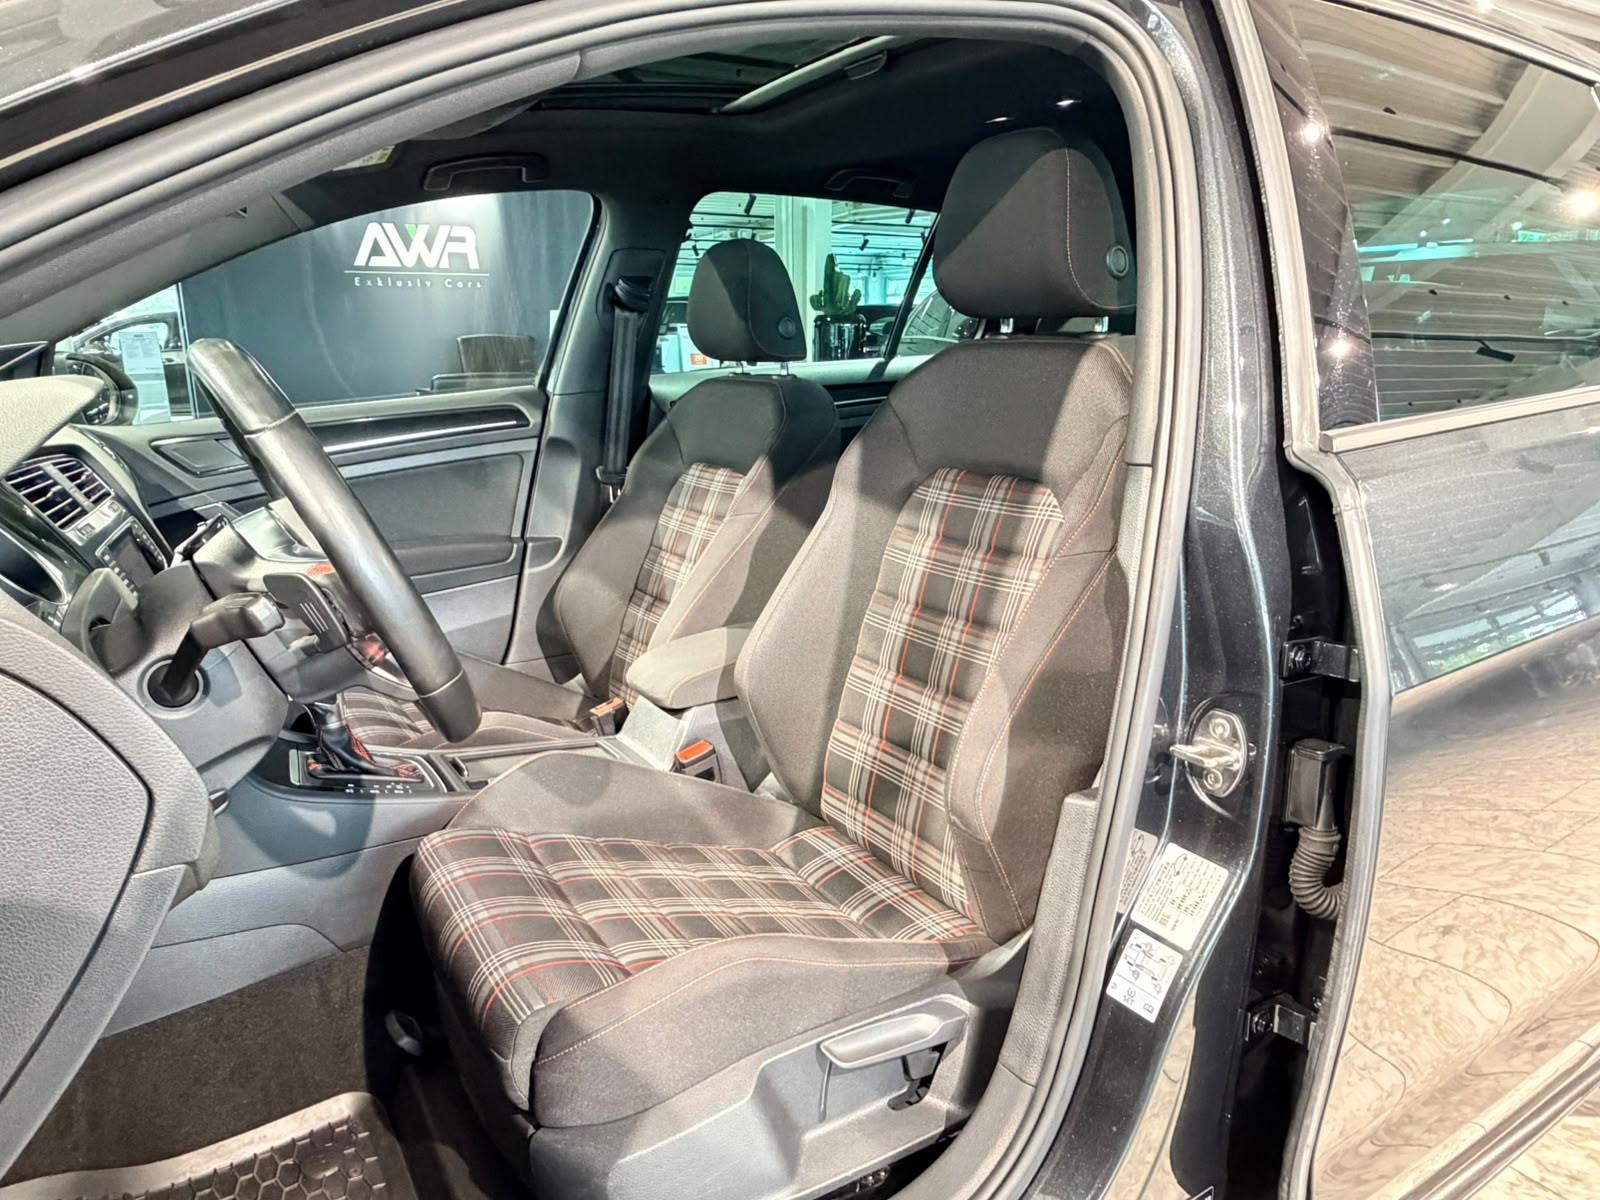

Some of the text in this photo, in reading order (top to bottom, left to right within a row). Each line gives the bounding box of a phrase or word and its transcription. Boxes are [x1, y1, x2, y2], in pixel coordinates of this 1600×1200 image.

[353, 222, 480, 269] AWR
[354, 277, 482, 288] Exklusiv Cars
